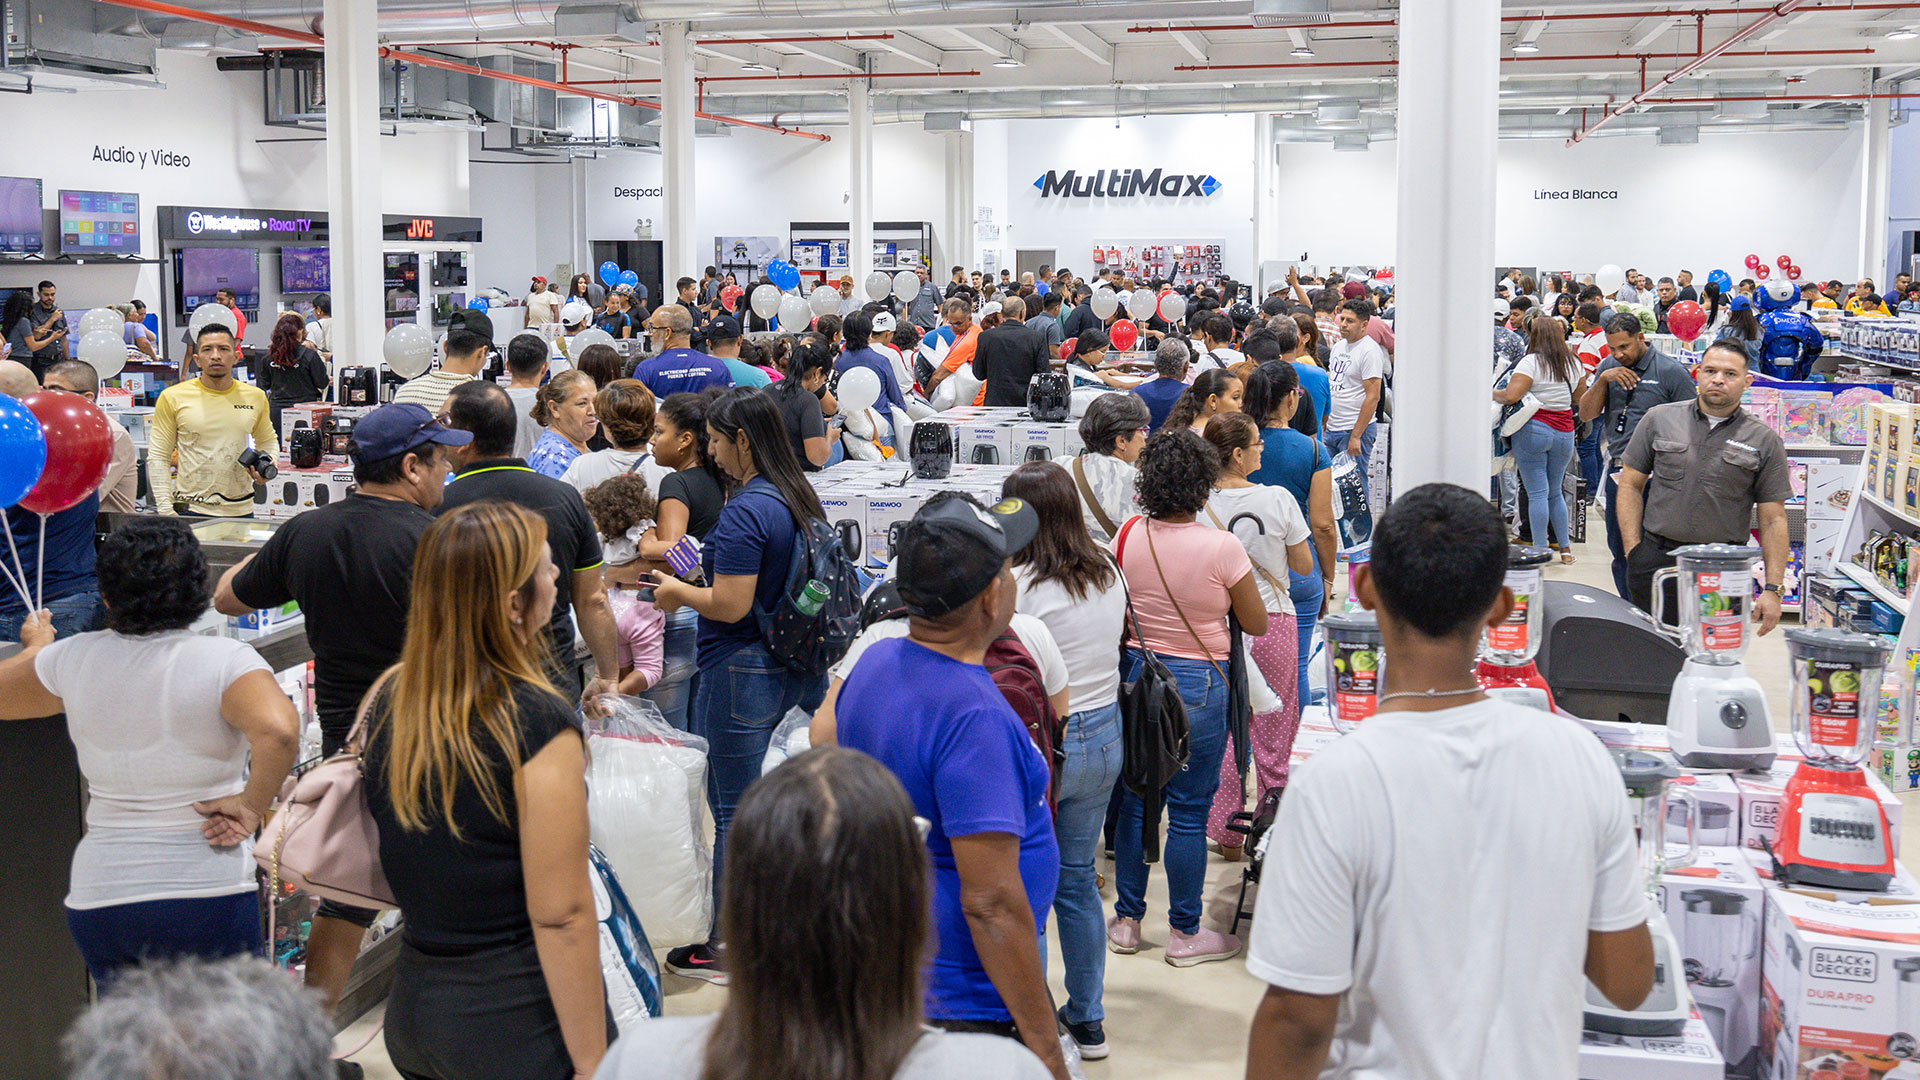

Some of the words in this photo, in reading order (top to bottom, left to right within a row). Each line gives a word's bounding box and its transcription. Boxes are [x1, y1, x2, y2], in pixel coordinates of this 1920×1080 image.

[92, 144, 135, 163] Audio
[139, 151, 148, 170] y
[151, 148, 191, 168] Video
[1041, 168, 1207, 198] MultiMax
[1534, 188, 1570, 200] Línea
[1572, 188, 1618, 200] Blanca
[268, 217, 296, 232] Roku
[297, 218, 312, 233] TV
[406, 218, 435, 239] JVC
[1815, 951, 1872, 968] BLACK+
[1814, 963, 1873, 979] DECKER
[1806, 988, 1875, 1004] DURAPRO
